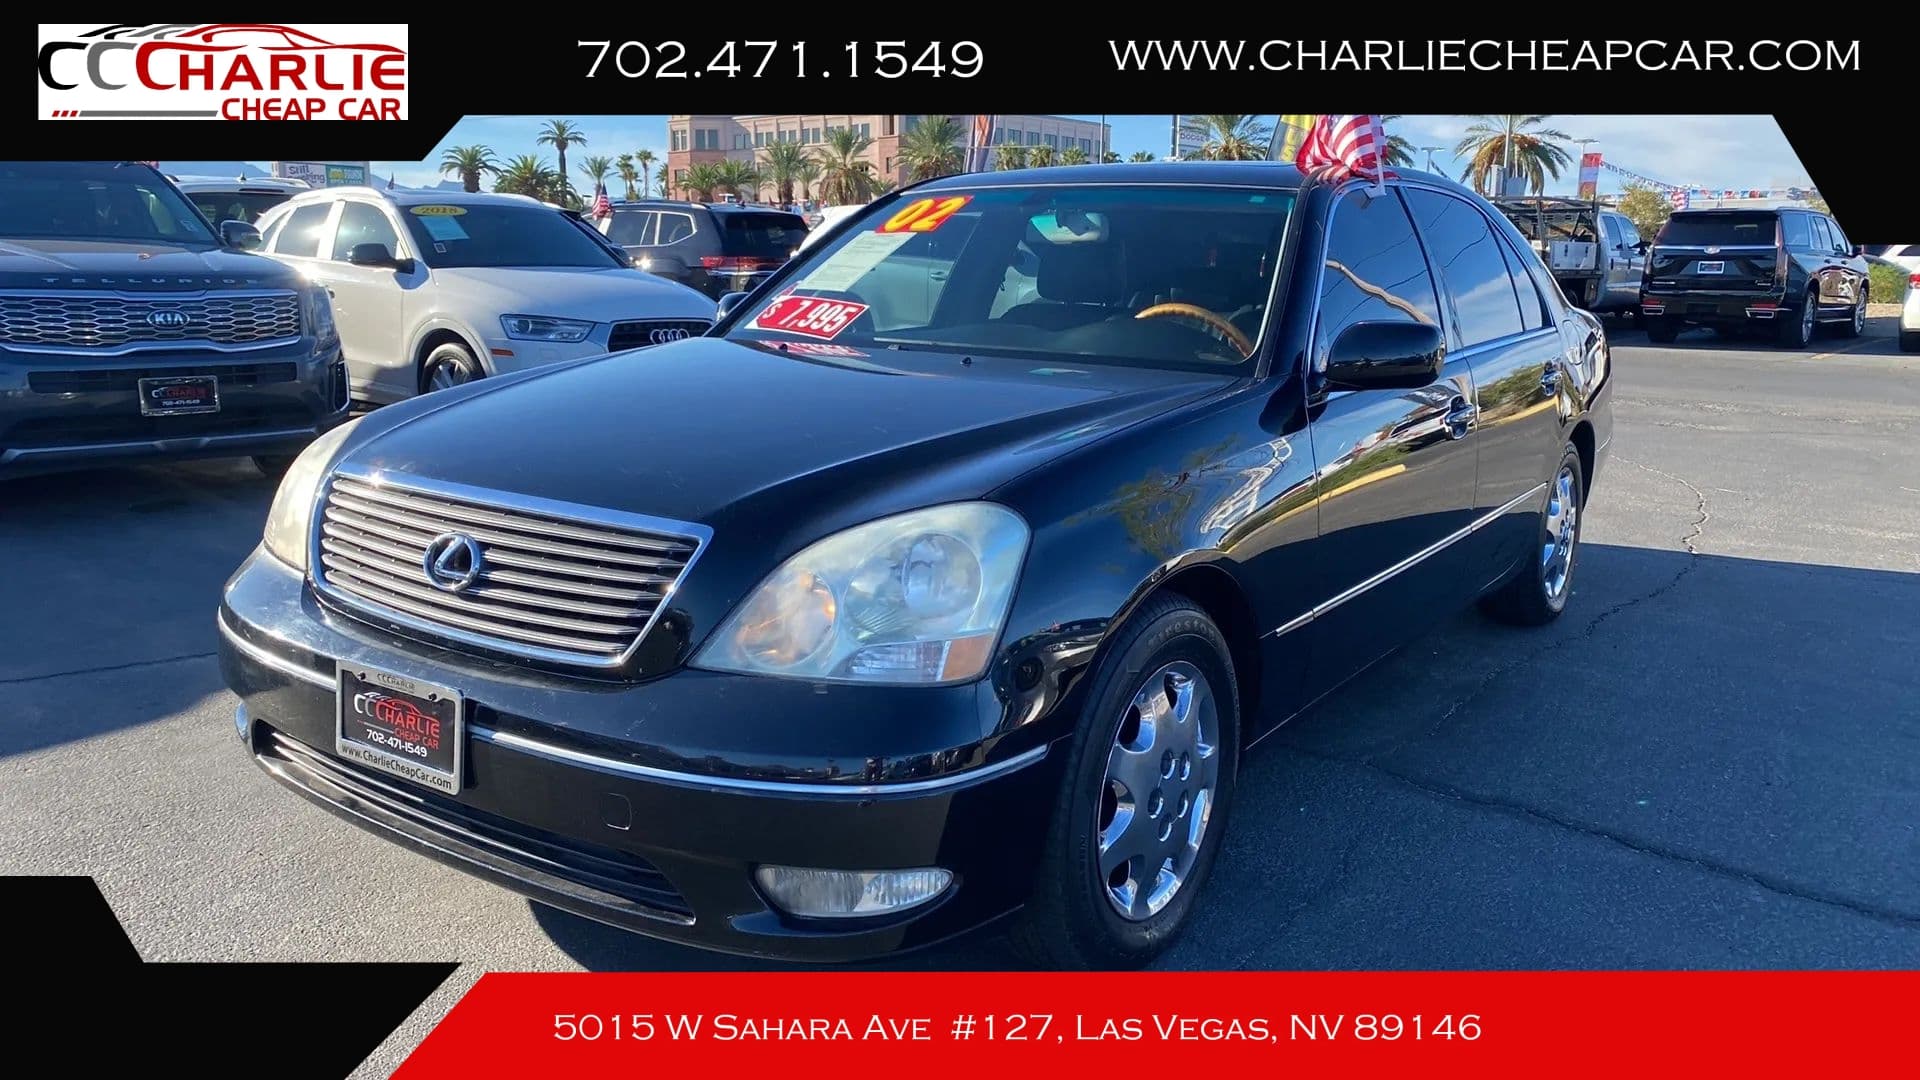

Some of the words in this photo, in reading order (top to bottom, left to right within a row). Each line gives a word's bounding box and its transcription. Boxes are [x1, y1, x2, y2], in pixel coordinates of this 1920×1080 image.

[884, 197, 965, 231] 02
[154, 313, 183, 325] KIA
[779, 303, 858, 332] 7,995
[366, 728, 428, 758] 702-471-1549
[394, 727, 420, 742] CHEAP
[422, 737, 439, 750] CAR
[341, 744, 452, 790] www.CharlieCheapCar.com
